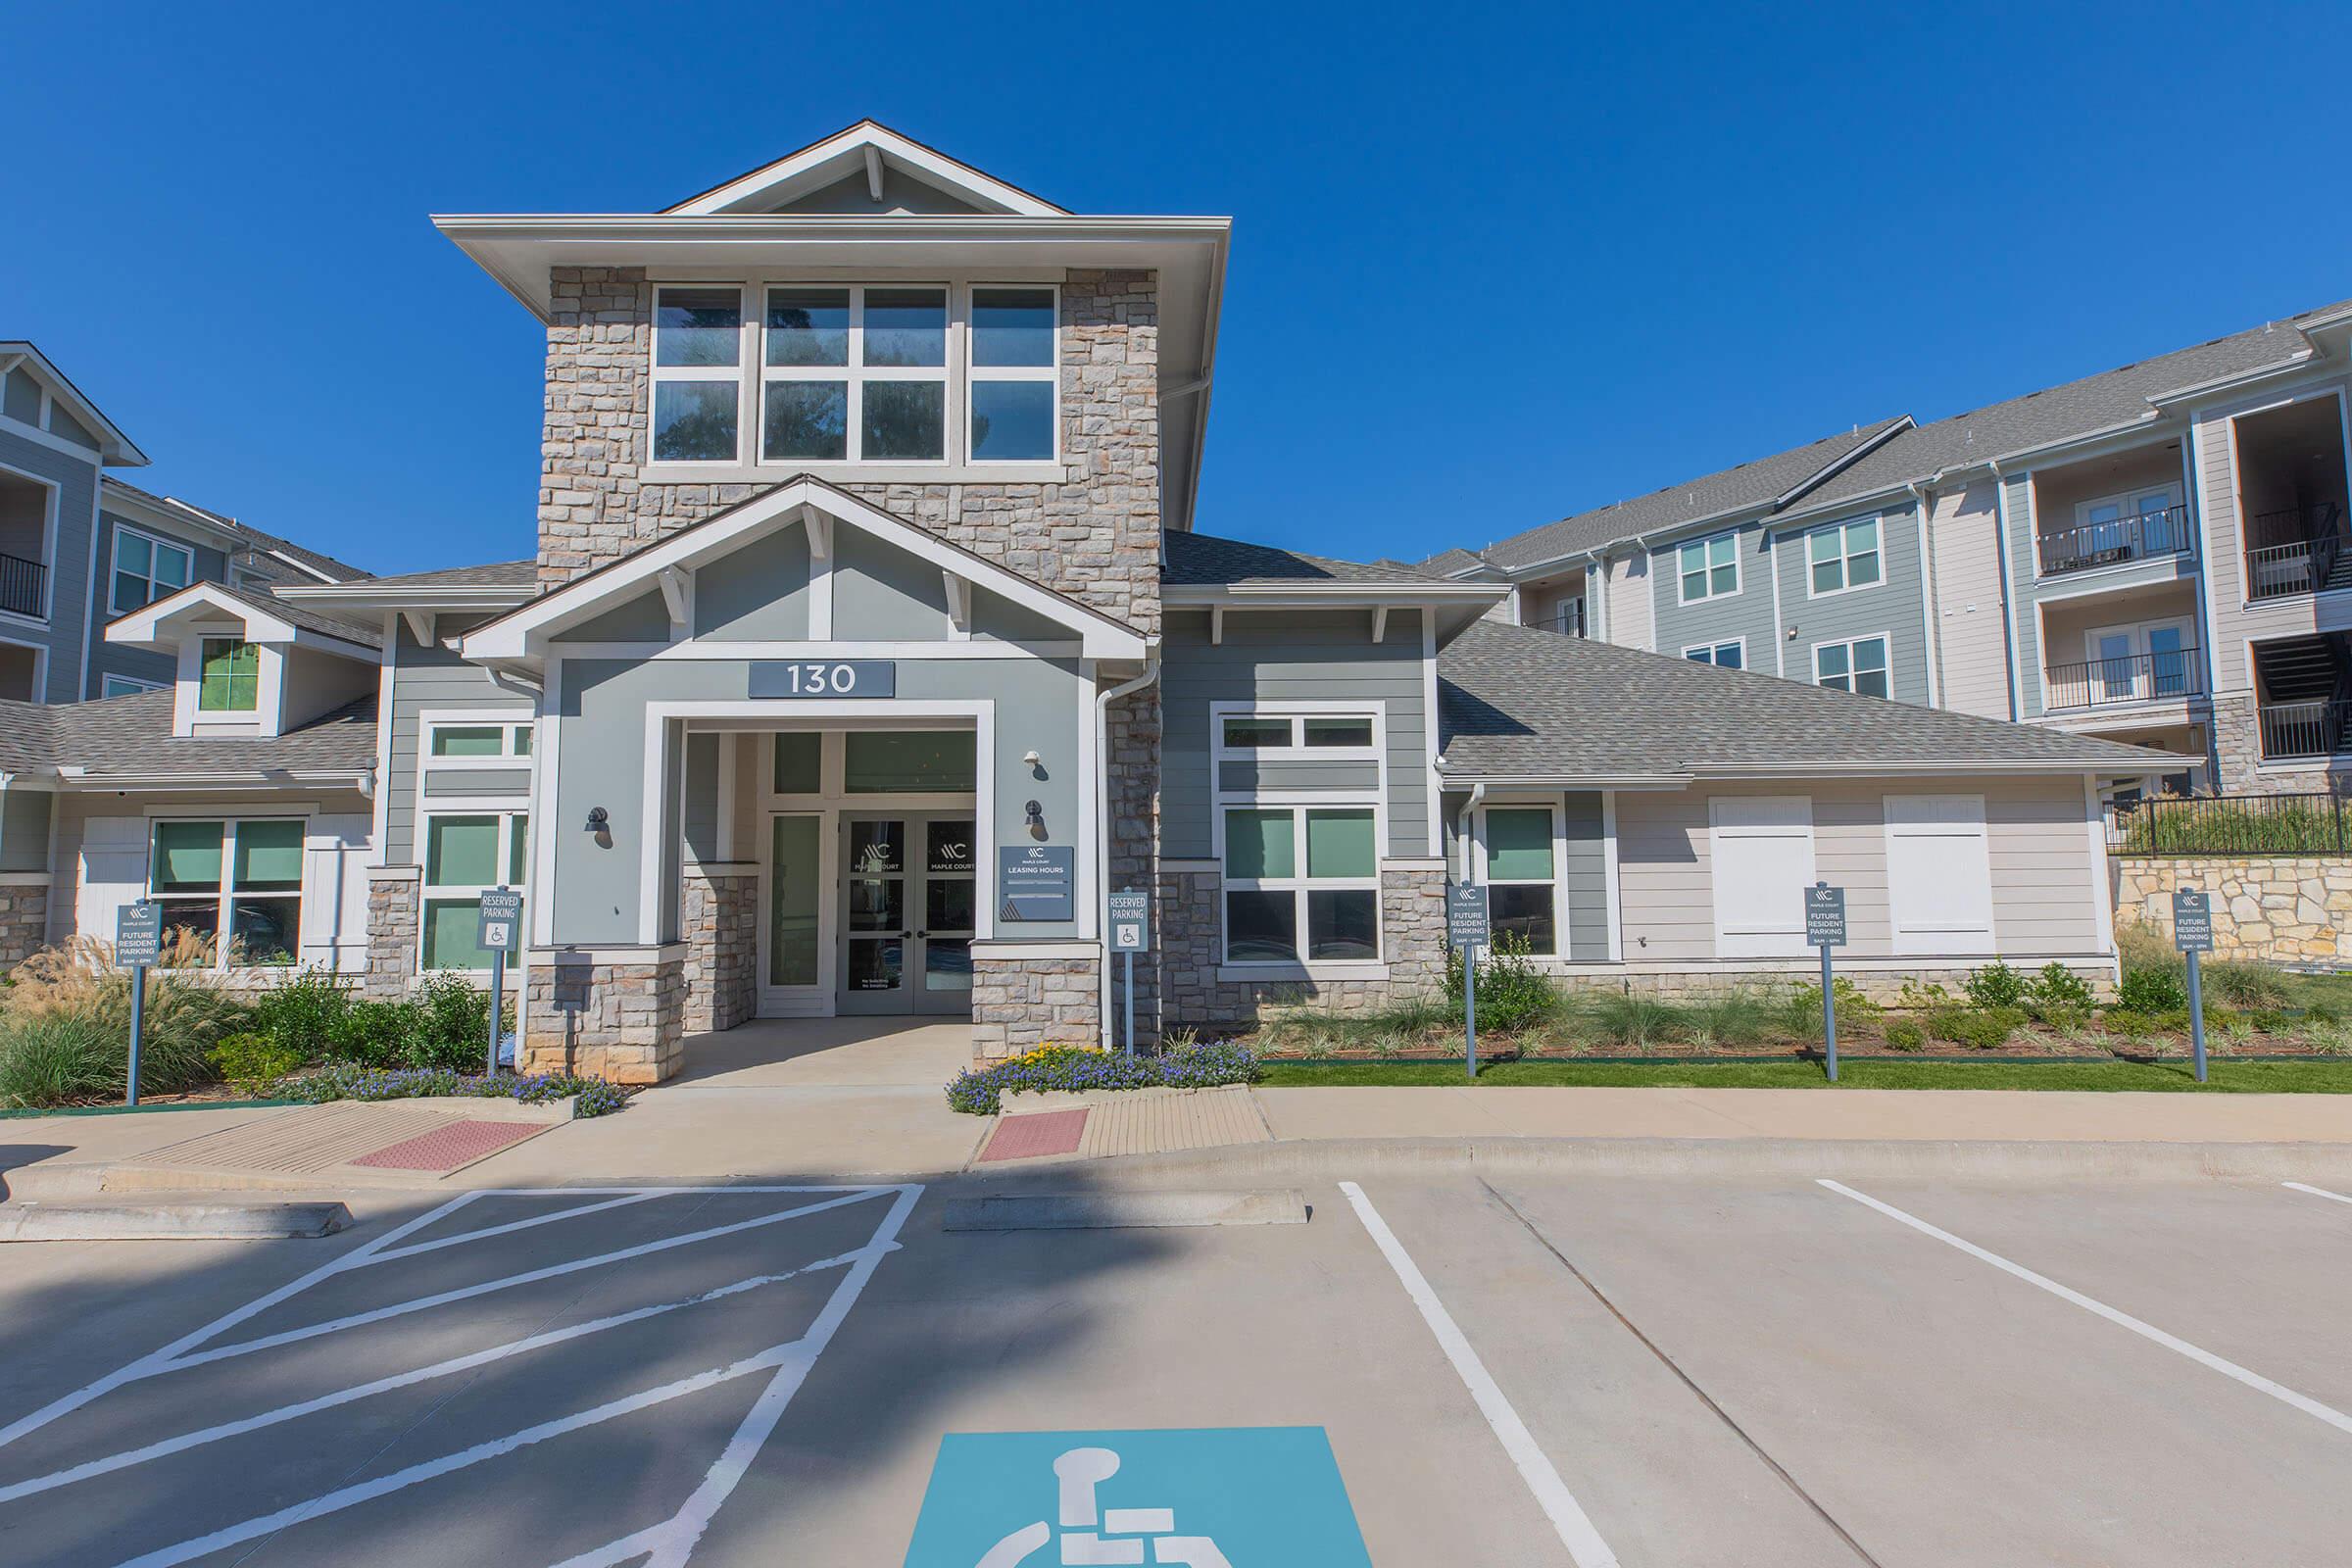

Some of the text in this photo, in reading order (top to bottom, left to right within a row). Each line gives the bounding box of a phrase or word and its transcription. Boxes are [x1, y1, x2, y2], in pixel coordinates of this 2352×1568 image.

[787, 664, 856, 693] 130
[482, 895, 518, 906] RESERVED
[1109, 897, 1146, 907] RESERVED
[483, 907, 515, 918] PARKING
[1112, 908, 1144, 919] PARKING
